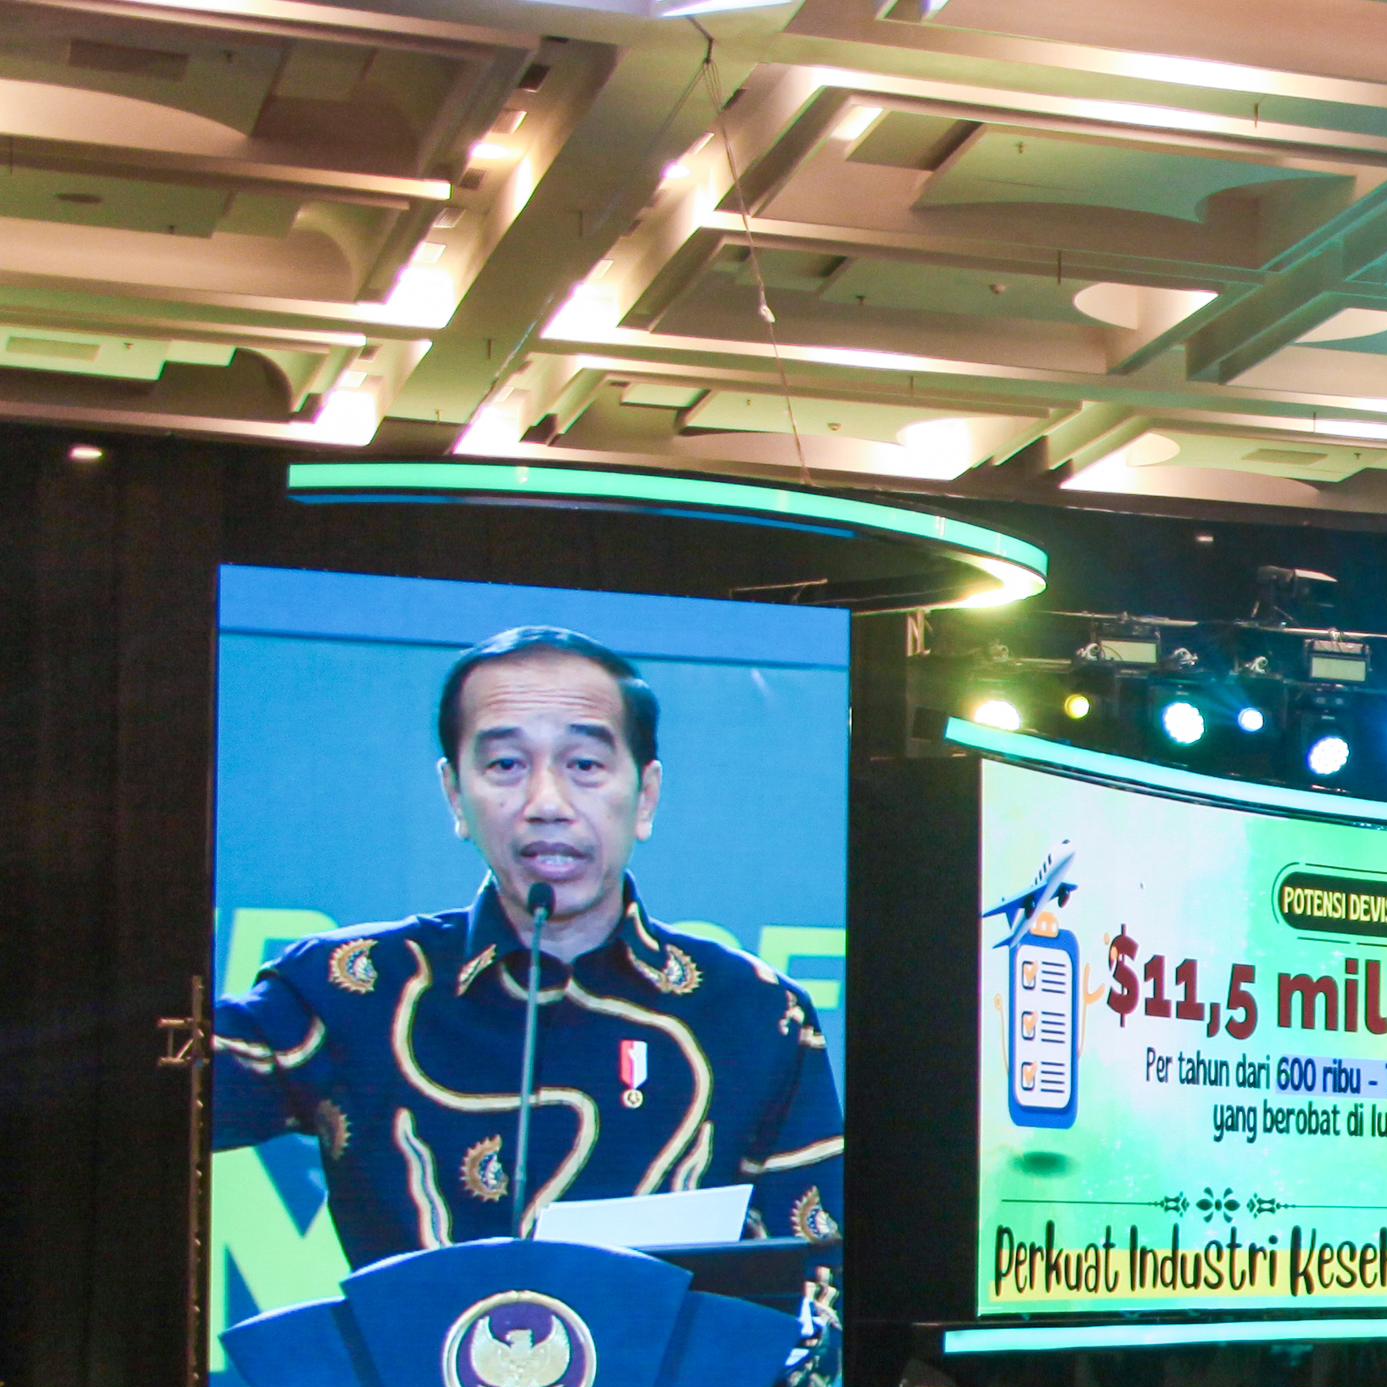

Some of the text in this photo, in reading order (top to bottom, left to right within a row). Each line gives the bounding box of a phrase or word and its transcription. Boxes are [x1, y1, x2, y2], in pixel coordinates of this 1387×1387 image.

[1283, 887, 1346, 920] POTENSI
[1107, 923, 1258, 1039] $11,5
[1146, 1048, 1172, 1084] Per
[1178, 1053, 1229, 1088] tahun
[1235, 1055, 1271, 1089] dari
[1277, 1057, 1316, 1091] 600
[1322, 1059, 1361, 1094] ribu
[1213, 1105, 1258, 1143] yang
[1263, 1103, 1340, 1137] berobat
[1346, 1104, 1364, 1137] di
[995, 1221, 1119, 1295] Perkuat
[1130, 1224, 1278, 1291] Industri
